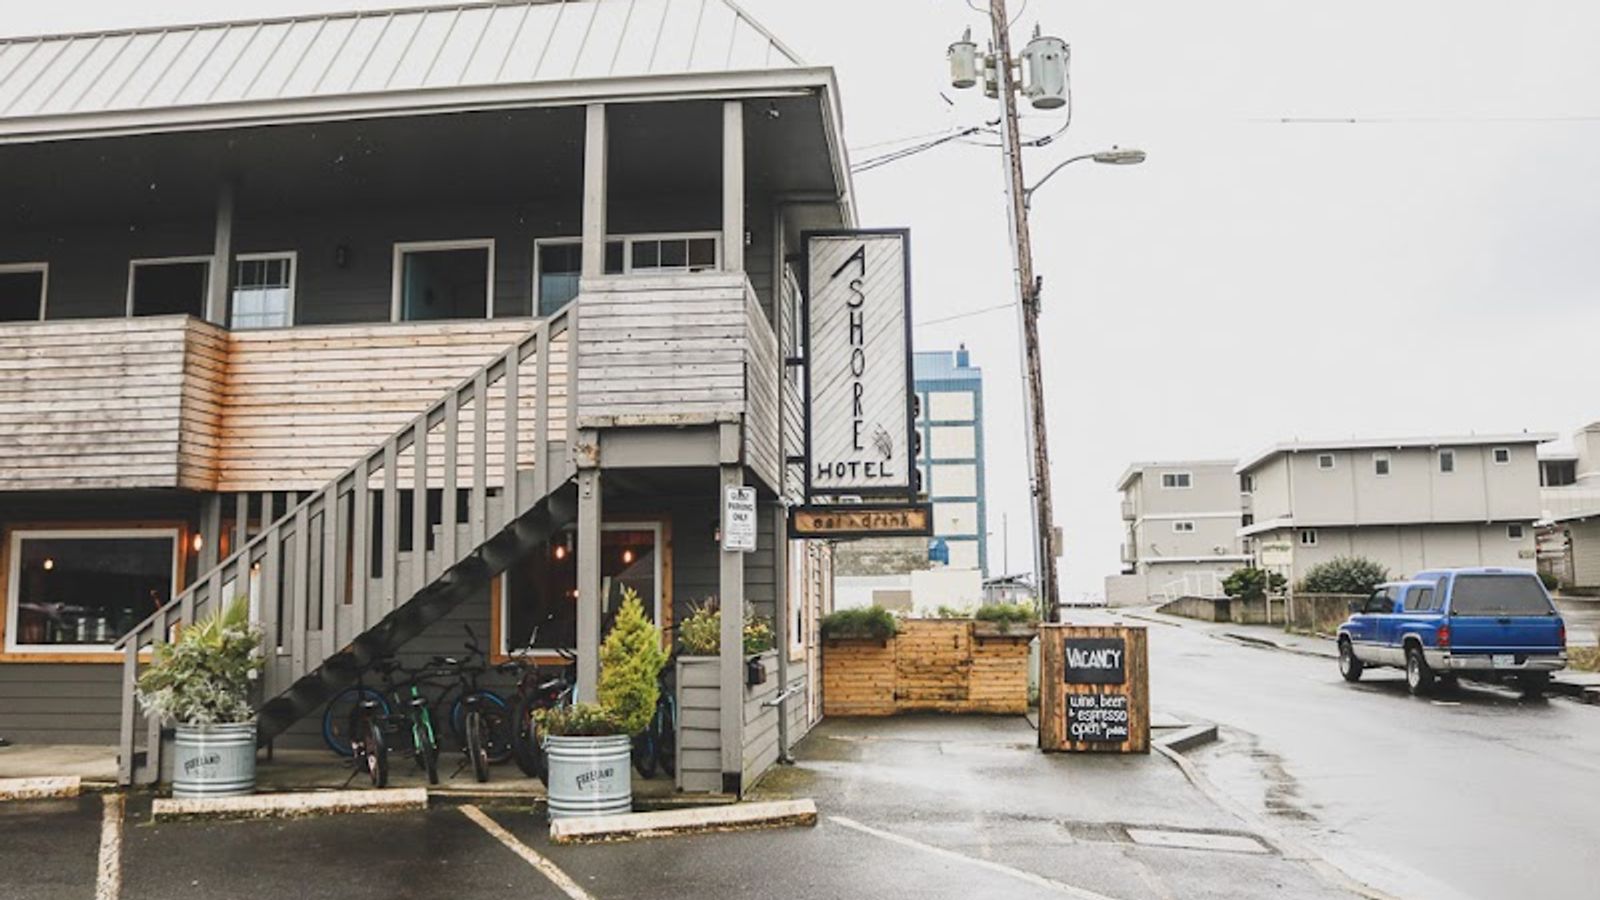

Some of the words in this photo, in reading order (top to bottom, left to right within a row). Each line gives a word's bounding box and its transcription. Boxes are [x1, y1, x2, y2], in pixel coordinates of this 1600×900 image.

[831, 244, 865, 451] ASHORE
[818, 462, 894, 479] HOTEL
[732, 512, 748, 521] ONLY
[862, 513, 910, 529] drink
[1066, 647, 1121, 669] VACANCY
[1100, 693, 1127, 707] beer
[1078, 710, 1127, 724] espresso
